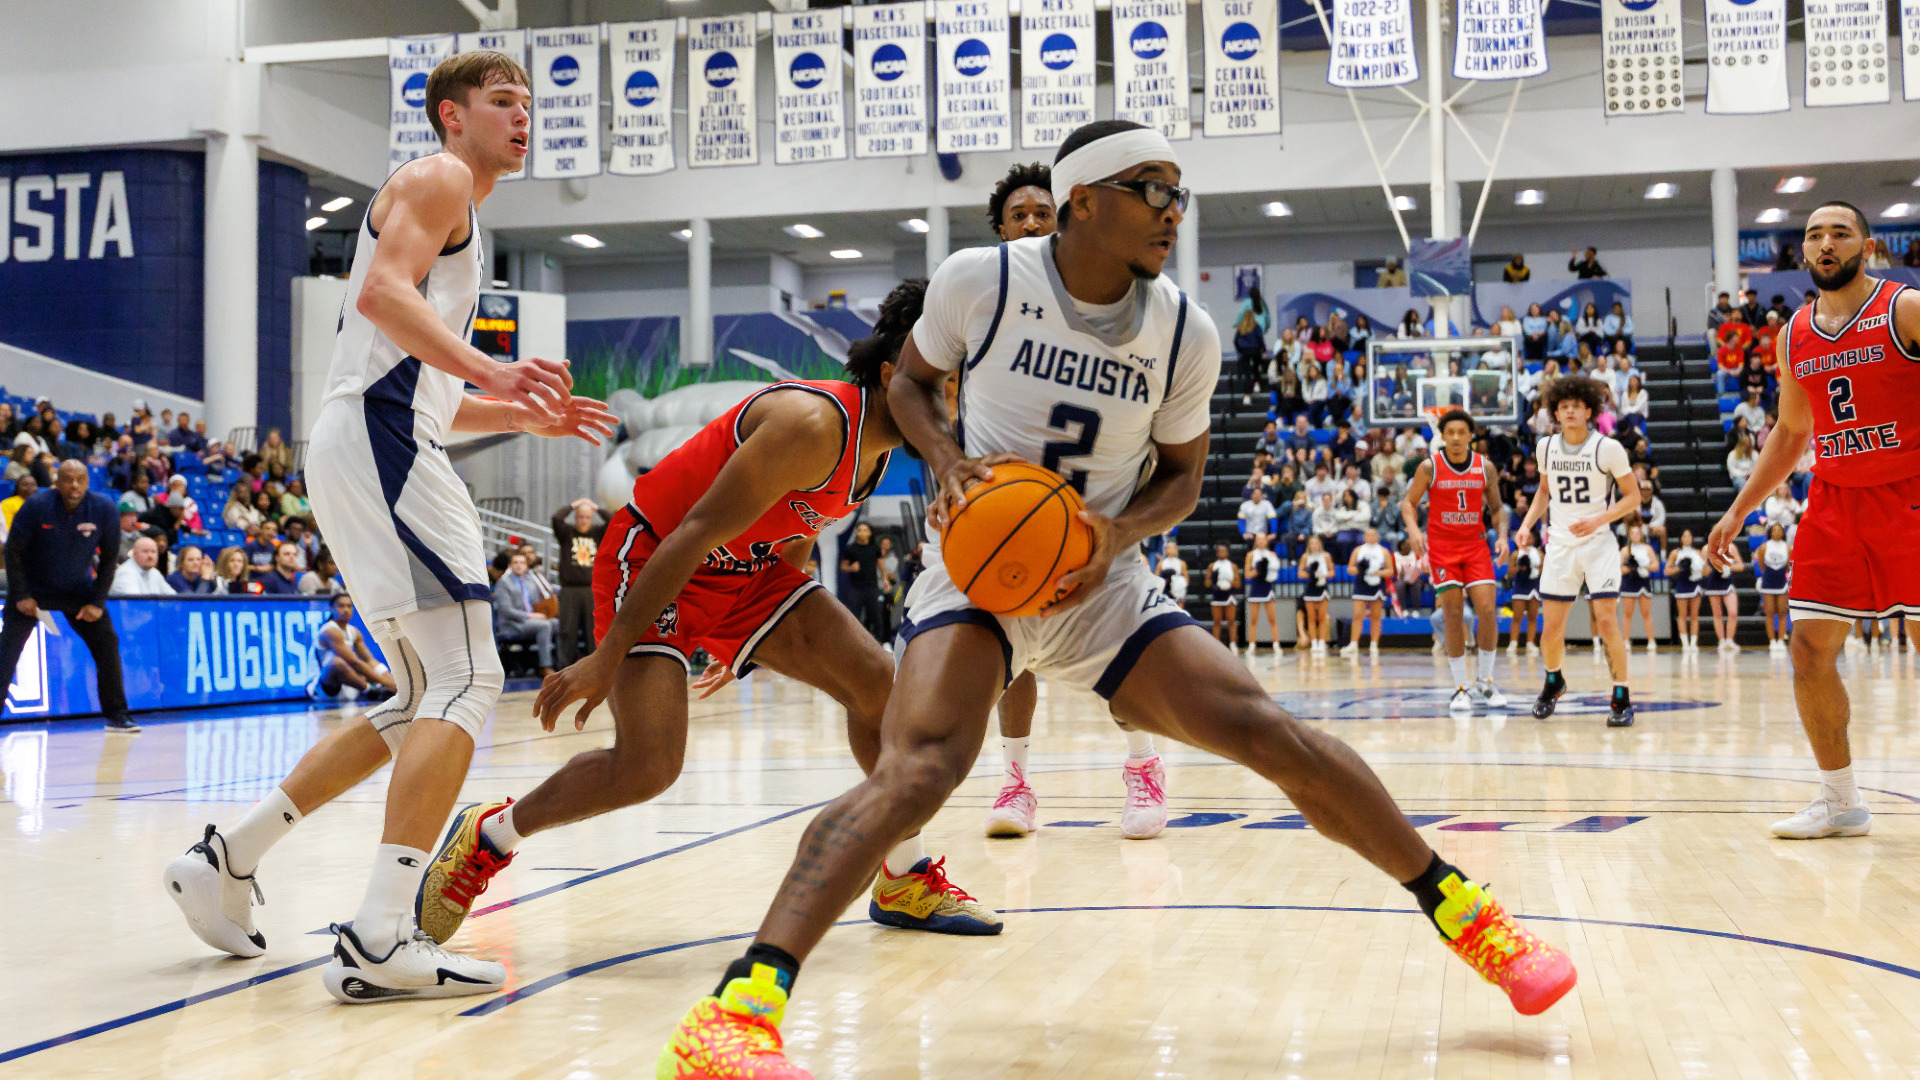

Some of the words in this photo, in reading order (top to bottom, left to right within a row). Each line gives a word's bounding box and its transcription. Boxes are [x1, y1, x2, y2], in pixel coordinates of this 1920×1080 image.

[873, 8, 905, 22] MEN'S
[955, 3, 988, 17] MEN'S
[1115, 2, 1183, 19] BASKETBALL
[1224, 2, 1253, 16] GOLF
[1807, 4, 1828, 14] NCAA
[1835, 2, 1869, 13] DIVISION
[792, 15, 823, 30] MEN'S
[1024, 14, 1091, 30] BASKETBALL
[1614, 15, 1655, 28] DIVISION
[1710, 12, 1732, 24] NCAA
[1736, 10, 1773, 22] DIVISION
[1810, 14, 1880, 29] CHAMPIONSHIP
[701, 20, 745, 35] WOMEN'S
[856, 24, 921, 40] BASKETBALL
[939, 19, 1005, 35] BASKETBALL
[1608, 28, 1676, 41] CHAMPIONSHIP
[1711, 23, 1780, 38] CHAMPIONSHIP
[479, 35, 506, 48] MEN'S
[536, 32, 593, 47] VOLLEYBALL
[628, 29, 657, 43] MEN'S
[689, 33, 753, 50] BASKETBALL
[777, 31, 838, 47] BASKETBALL
[1467, 32, 1533, 52] TOURNAMENT
[1814, 29, 1877, 41] PARTICIPANT
[1132, 38, 1169, 53] NCAA
[1224, 38, 1262, 54] NCAA
[1609, 41, 1677, 55] APPEARANCES
[1713, 38, 1779, 52] APPEARANCES
[625, 49, 661, 63] TENNIS
[956, 55, 991, 69] NCAA
[1042, 48, 1078, 64] NCAA
[1465, 52, 1538, 71] CHAMPIONS
[874, 59, 908, 74] NCAA
[1134, 61, 1168, 77] SOUTH
[1337, 60, 1409, 80] CHAMPIONS
[1022, 76, 1048, 89] SOUTH
[1057, 73, 1093, 88] ATLANTIC
[1215, 67, 1267, 82] CENTRAL
[859, 85, 921, 101] SOUTHEAST
[943, 80, 1005, 96] SOUTHEAST
[1126, 78, 1176, 93] ATLANTIC
[1214, 82, 1269, 98] REGIONAL
[537, 94, 592, 109] SOUTHEAST
[706, 90, 738, 103] SOUTH
[778, 91, 840, 108] SOUTHEAST
[1031, 92, 1085, 107] REGIONAL
[1125, 94, 1177, 109] REGIONAL
[699, 104, 746, 118] ATLANTIC
[864, 103, 916, 118] REGIONAL
[947, 98, 999, 113] REGIONAL
[1210, 98, 1274, 114] CHAMPIONS
[782, 110, 835, 126] REGIONAL
[1167, 107, 1188, 122] SEED
[1227, 114, 1257, 129] 2005
[544, 116, 586, 129] REGIONAL
[699, 119, 746, 132] REGIONAL
[695, 132, 751, 147] CHAMPIONS
[868, 138, 913, 152] 2009-10
[1857, 314, 1889, 333] PBC
[497, 333, 511, 353] 9
[1795, 345, 1885, 379] COLUMBUS
[1009, 339, 1151, 404] AUGUSTA
[1828, 376, 1857, 424] 2
[1818, 422, 1902, 458] STATE
[1041, 400, 1103, 497] 2
[1551, 460, 1592, 472] AUGUSTA
[1557, 476, 1590, 503] 22
[1456, 490, 1467, 510] 1
[1441, 512, 1480, 524] STATE
